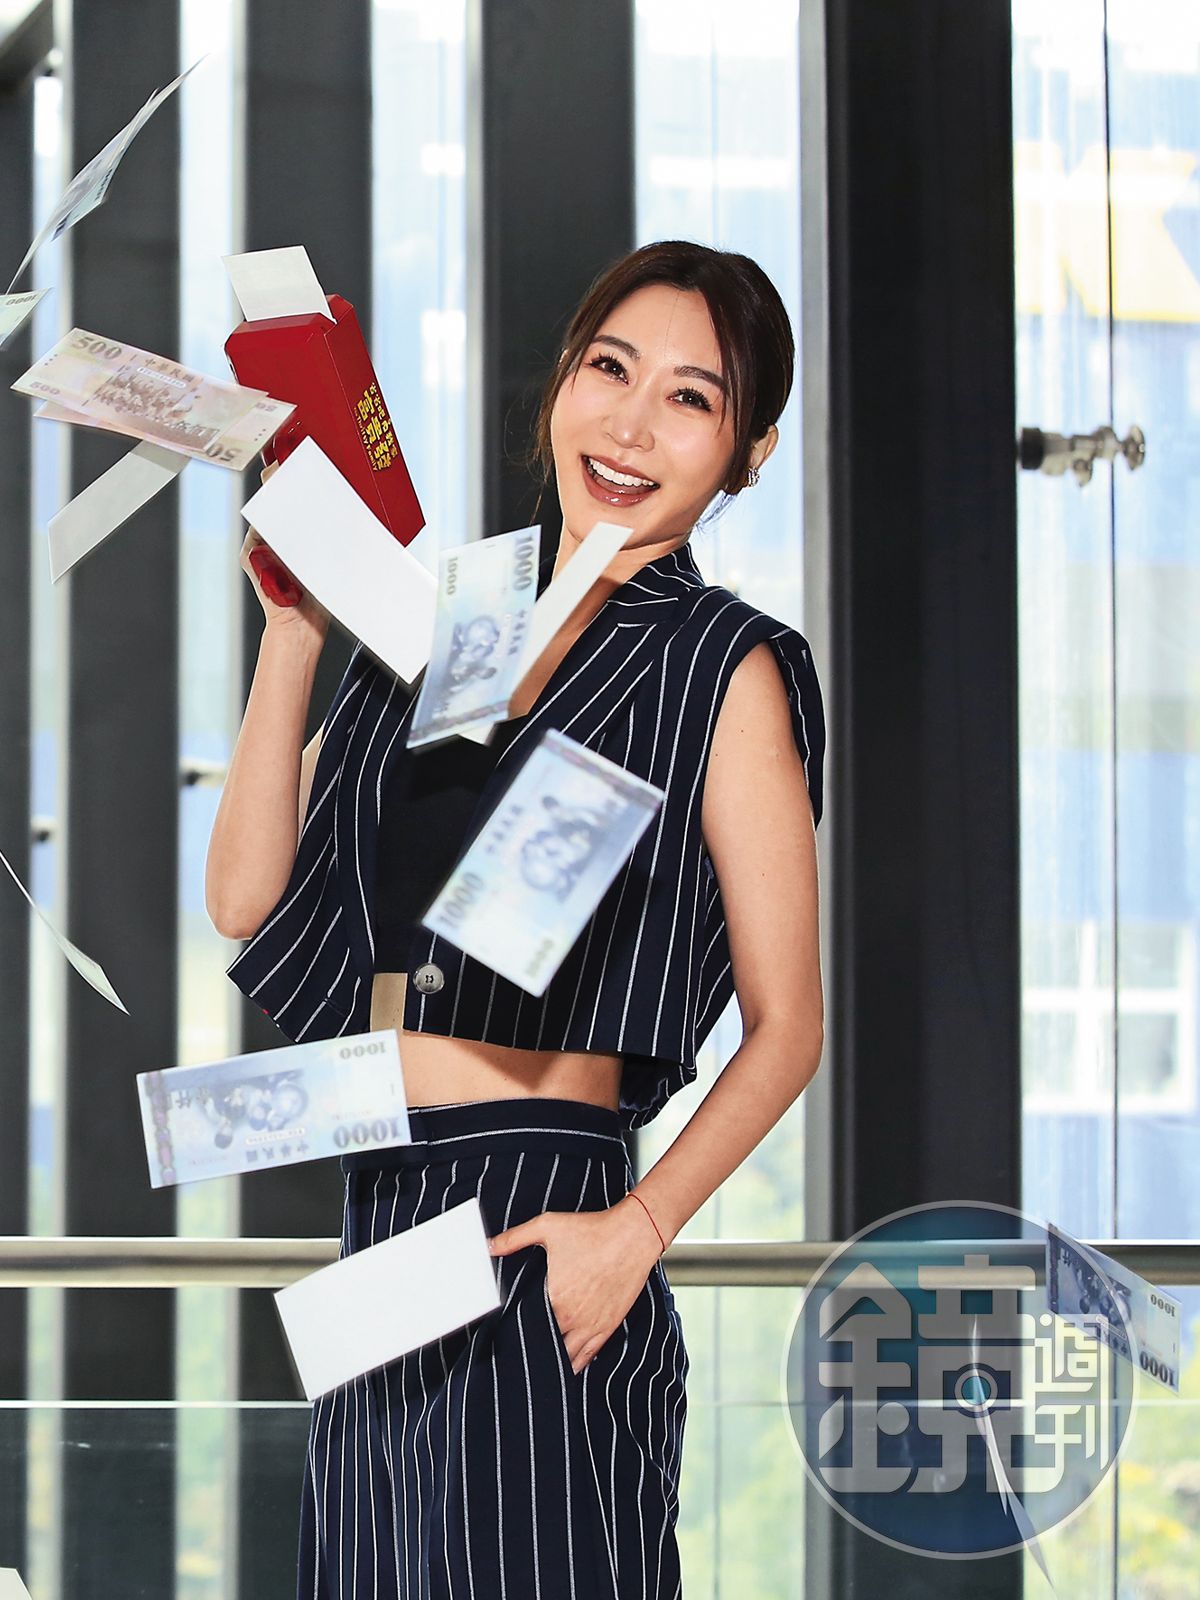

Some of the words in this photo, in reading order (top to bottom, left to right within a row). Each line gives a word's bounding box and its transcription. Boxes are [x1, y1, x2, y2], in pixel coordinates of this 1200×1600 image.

[71, 336, 123, 360] 500
[29, 381, 61, 396] 500
[446, 557, 458, 595] 1000
[513, 535, 534, 592] 1000
[339, 1042, 386, 1060] 1000
[333, 1117, 400, 1150] 1000
[1151, 1294, 1176, 1318] 1000
[1139, 1350, 1175, 1387] 1000
